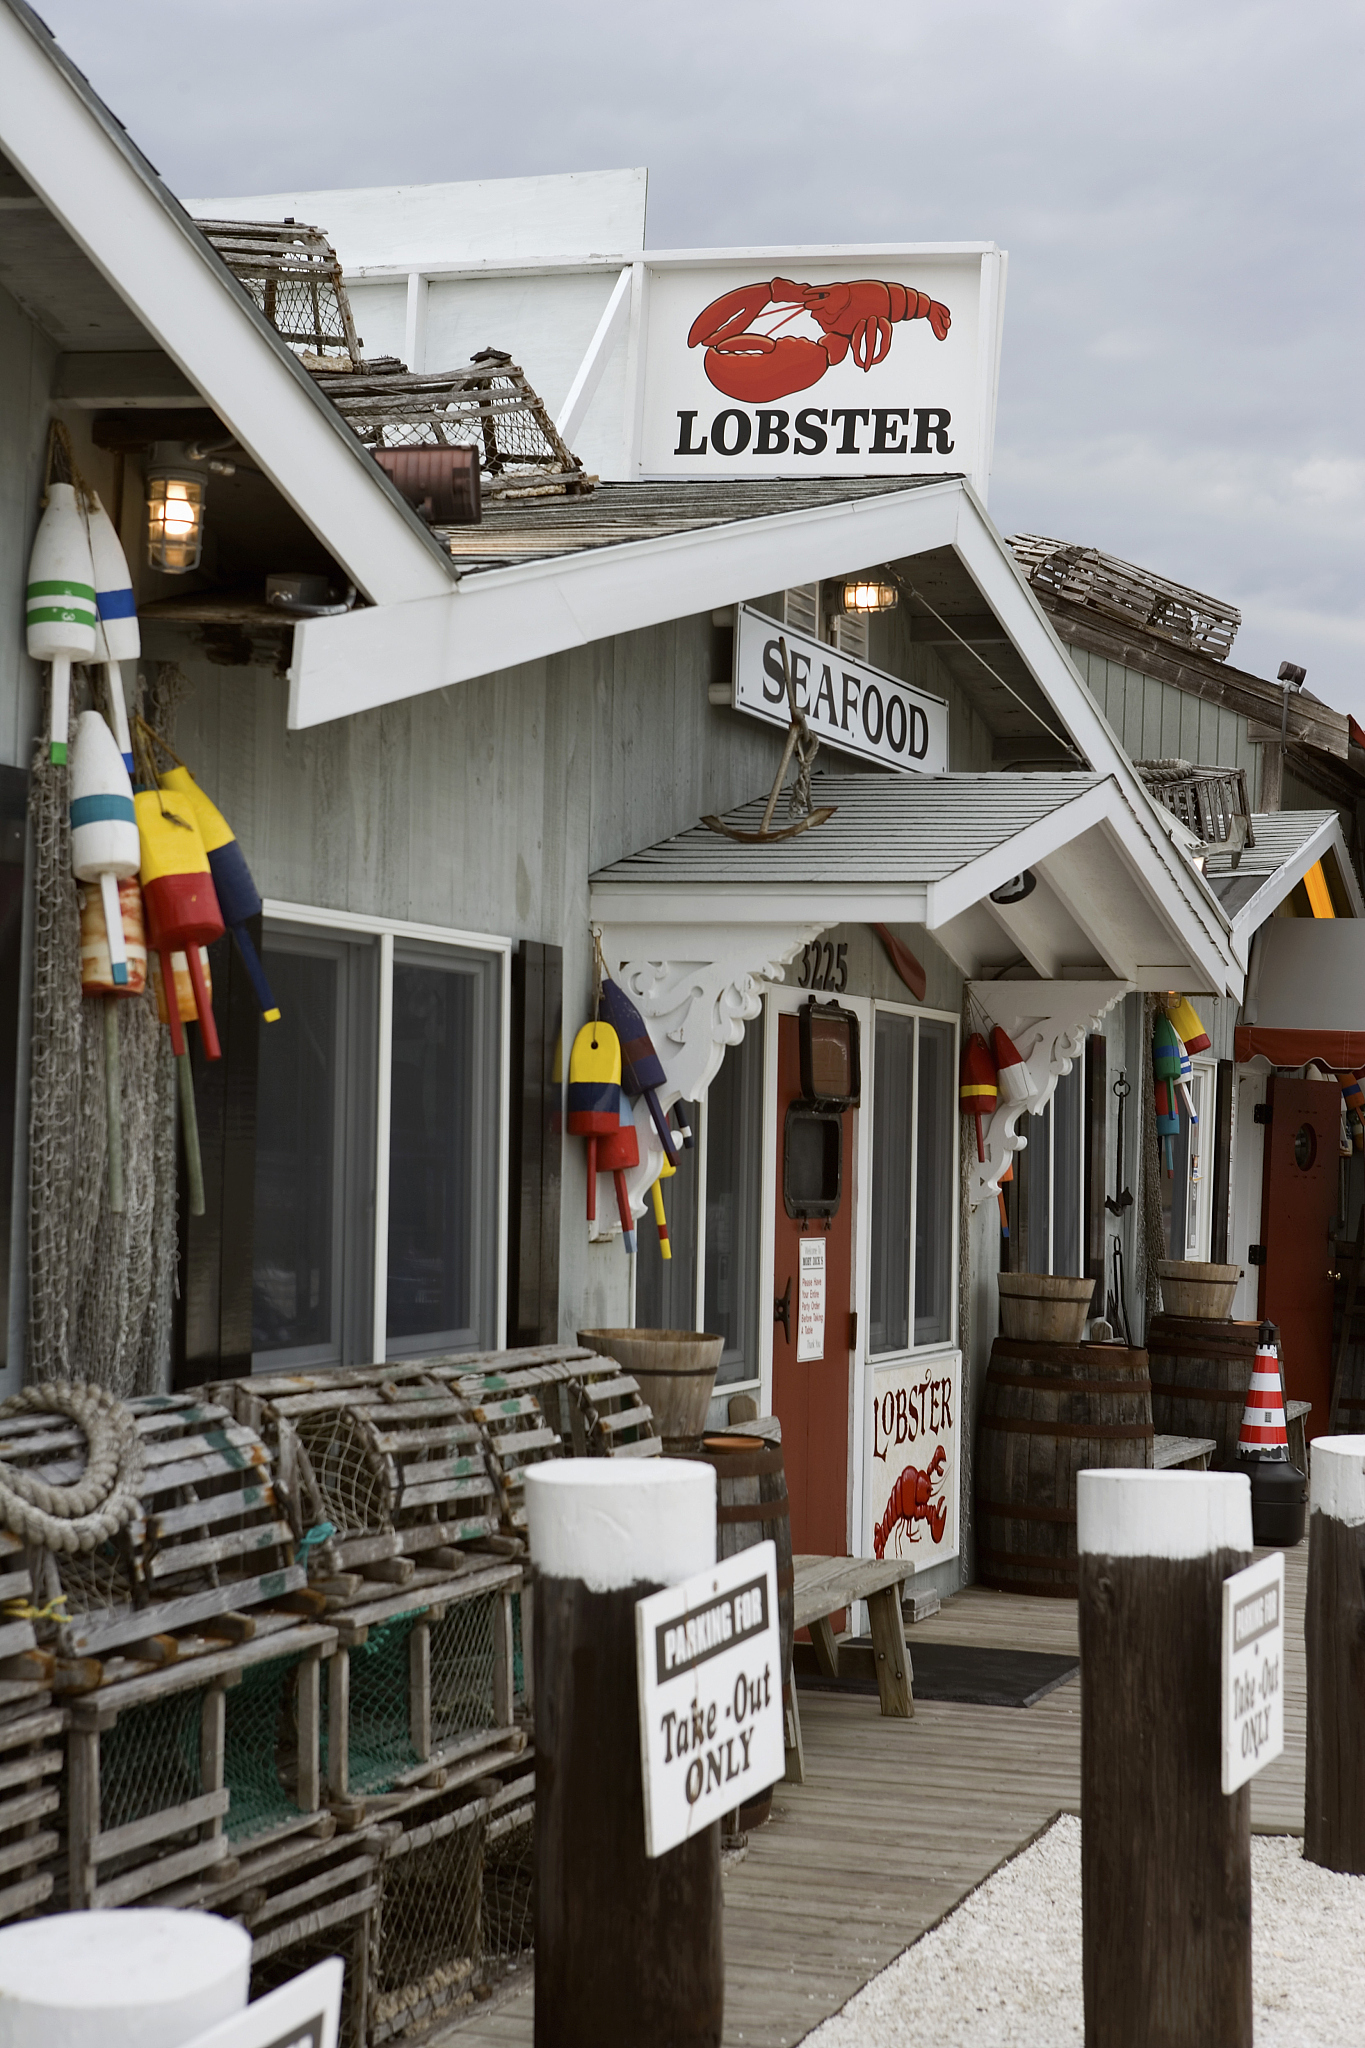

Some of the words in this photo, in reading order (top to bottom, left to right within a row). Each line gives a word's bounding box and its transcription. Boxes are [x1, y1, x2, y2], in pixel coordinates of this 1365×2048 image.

[673, 407, 955, 456] LOBSTER
[762, 639, 929, 761] SEAFOOD
[798, 940, 848, 993] 3225
[802, 1278, 812, 1287] Please
[802, 1302, 810, 1312] Party
[811, 1301, 820, 1310] Order
[801, 1314, 812, 1323] Before
[805, 1326, 813, 1334] Table
[873, 1368, 954, 1462] LOBSTER
[664, 1601, 732, 1670] PARKING
[734, 1586, 763, 1634] FOR
[1235, 1596, 1264, 1642] PARKING
[1264, 1589, 1277, 1624] FOR
[660, 1697, 716, 1765] Take
[1240, 1703, 1272, 1760] ONLY
[685, 1724, 755, 1805] ONLY
